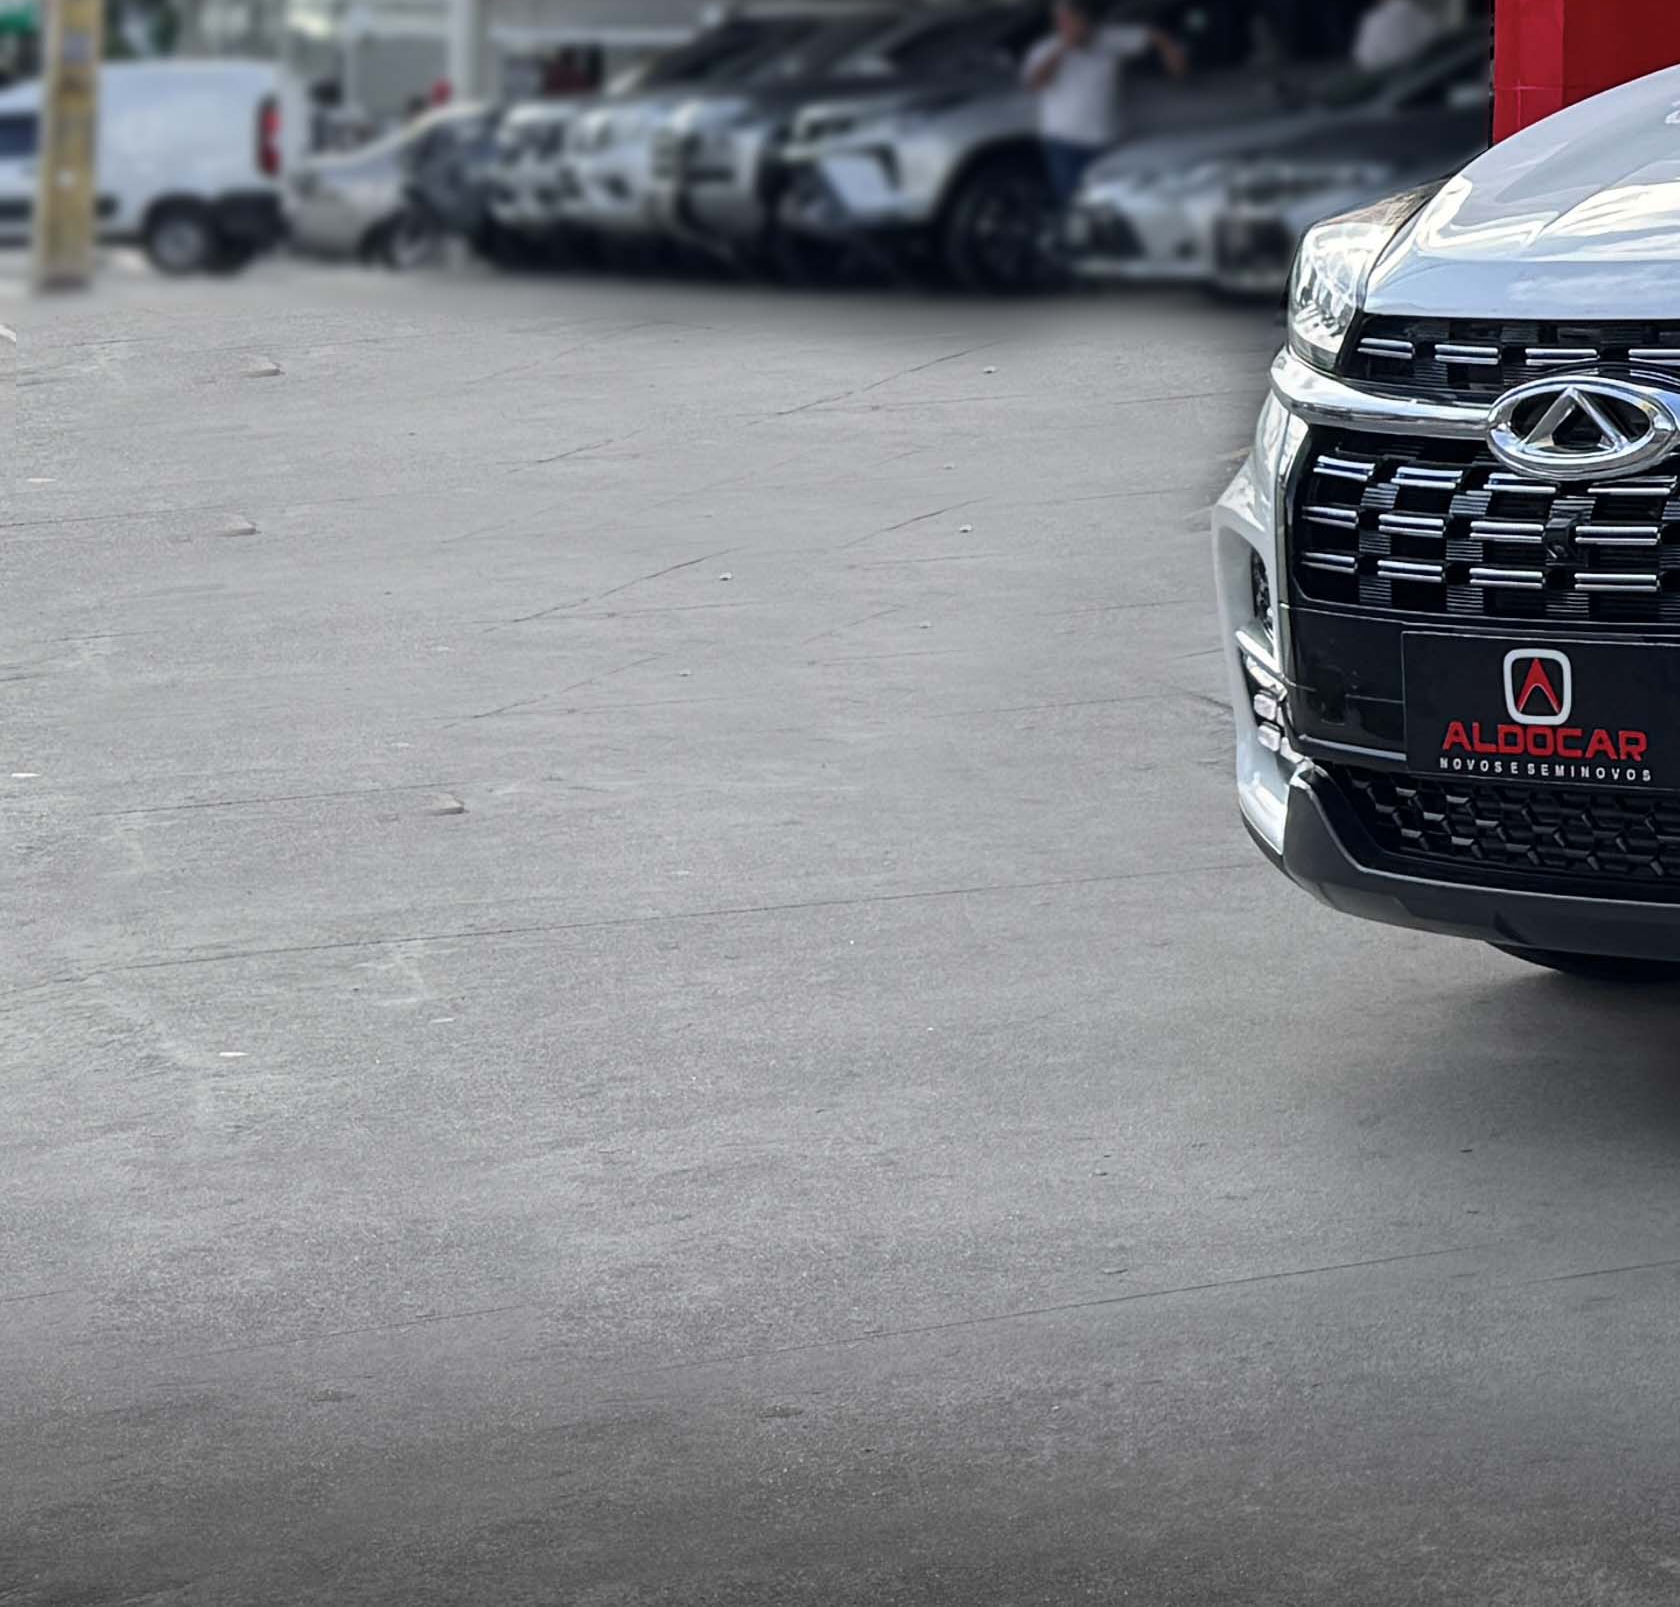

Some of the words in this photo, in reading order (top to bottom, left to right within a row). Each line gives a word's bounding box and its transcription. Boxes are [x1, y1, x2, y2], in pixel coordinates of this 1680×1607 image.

[1442, 721, 1648, 762] ALDOCAR
[1440, 757, 1503, 774] NOVOS
[1510, 762, 1519, 775] E
[1527, 763, 1652, 782] SEMINOVOS
